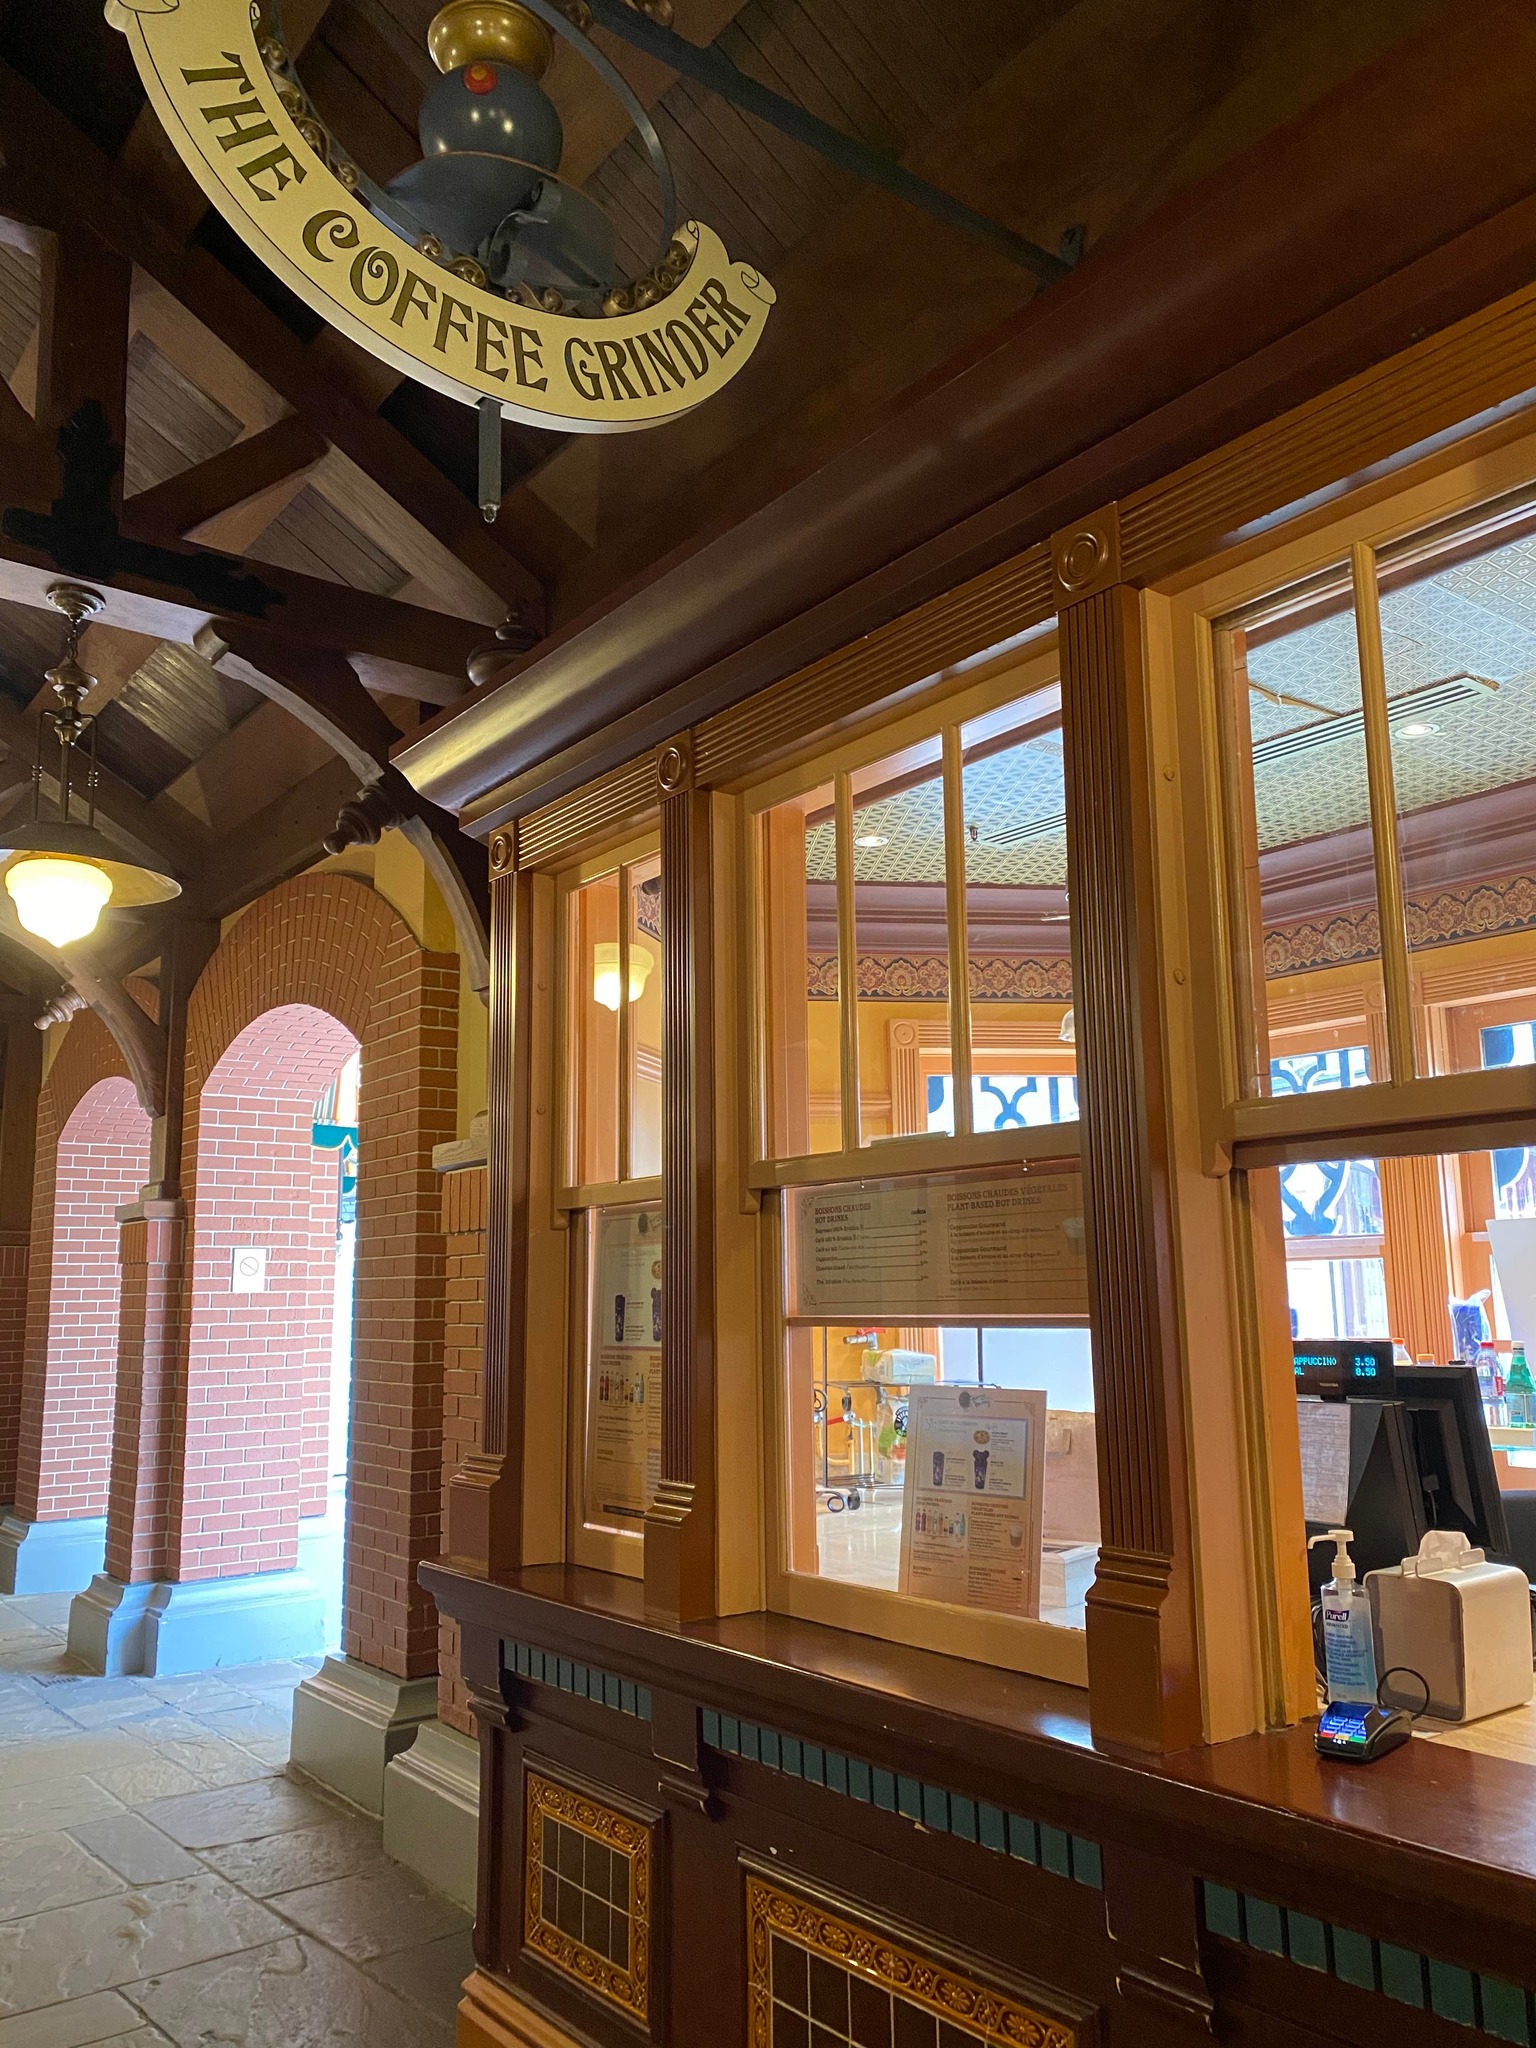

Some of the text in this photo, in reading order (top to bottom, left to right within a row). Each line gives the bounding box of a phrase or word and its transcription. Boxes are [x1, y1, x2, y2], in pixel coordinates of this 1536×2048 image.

[180, 51, 752, 402] THE COFFEE GRINDER
[982, 1187, 1019, 1199] CHAUDES
[995, 1198, 1011, 1207] HOT
[1012, 1196, 1041, 1206] DRINKS
[1355, 1357, 1376, 1366] 3.50
[1355, 1367, 1377, 1377] 8.50
